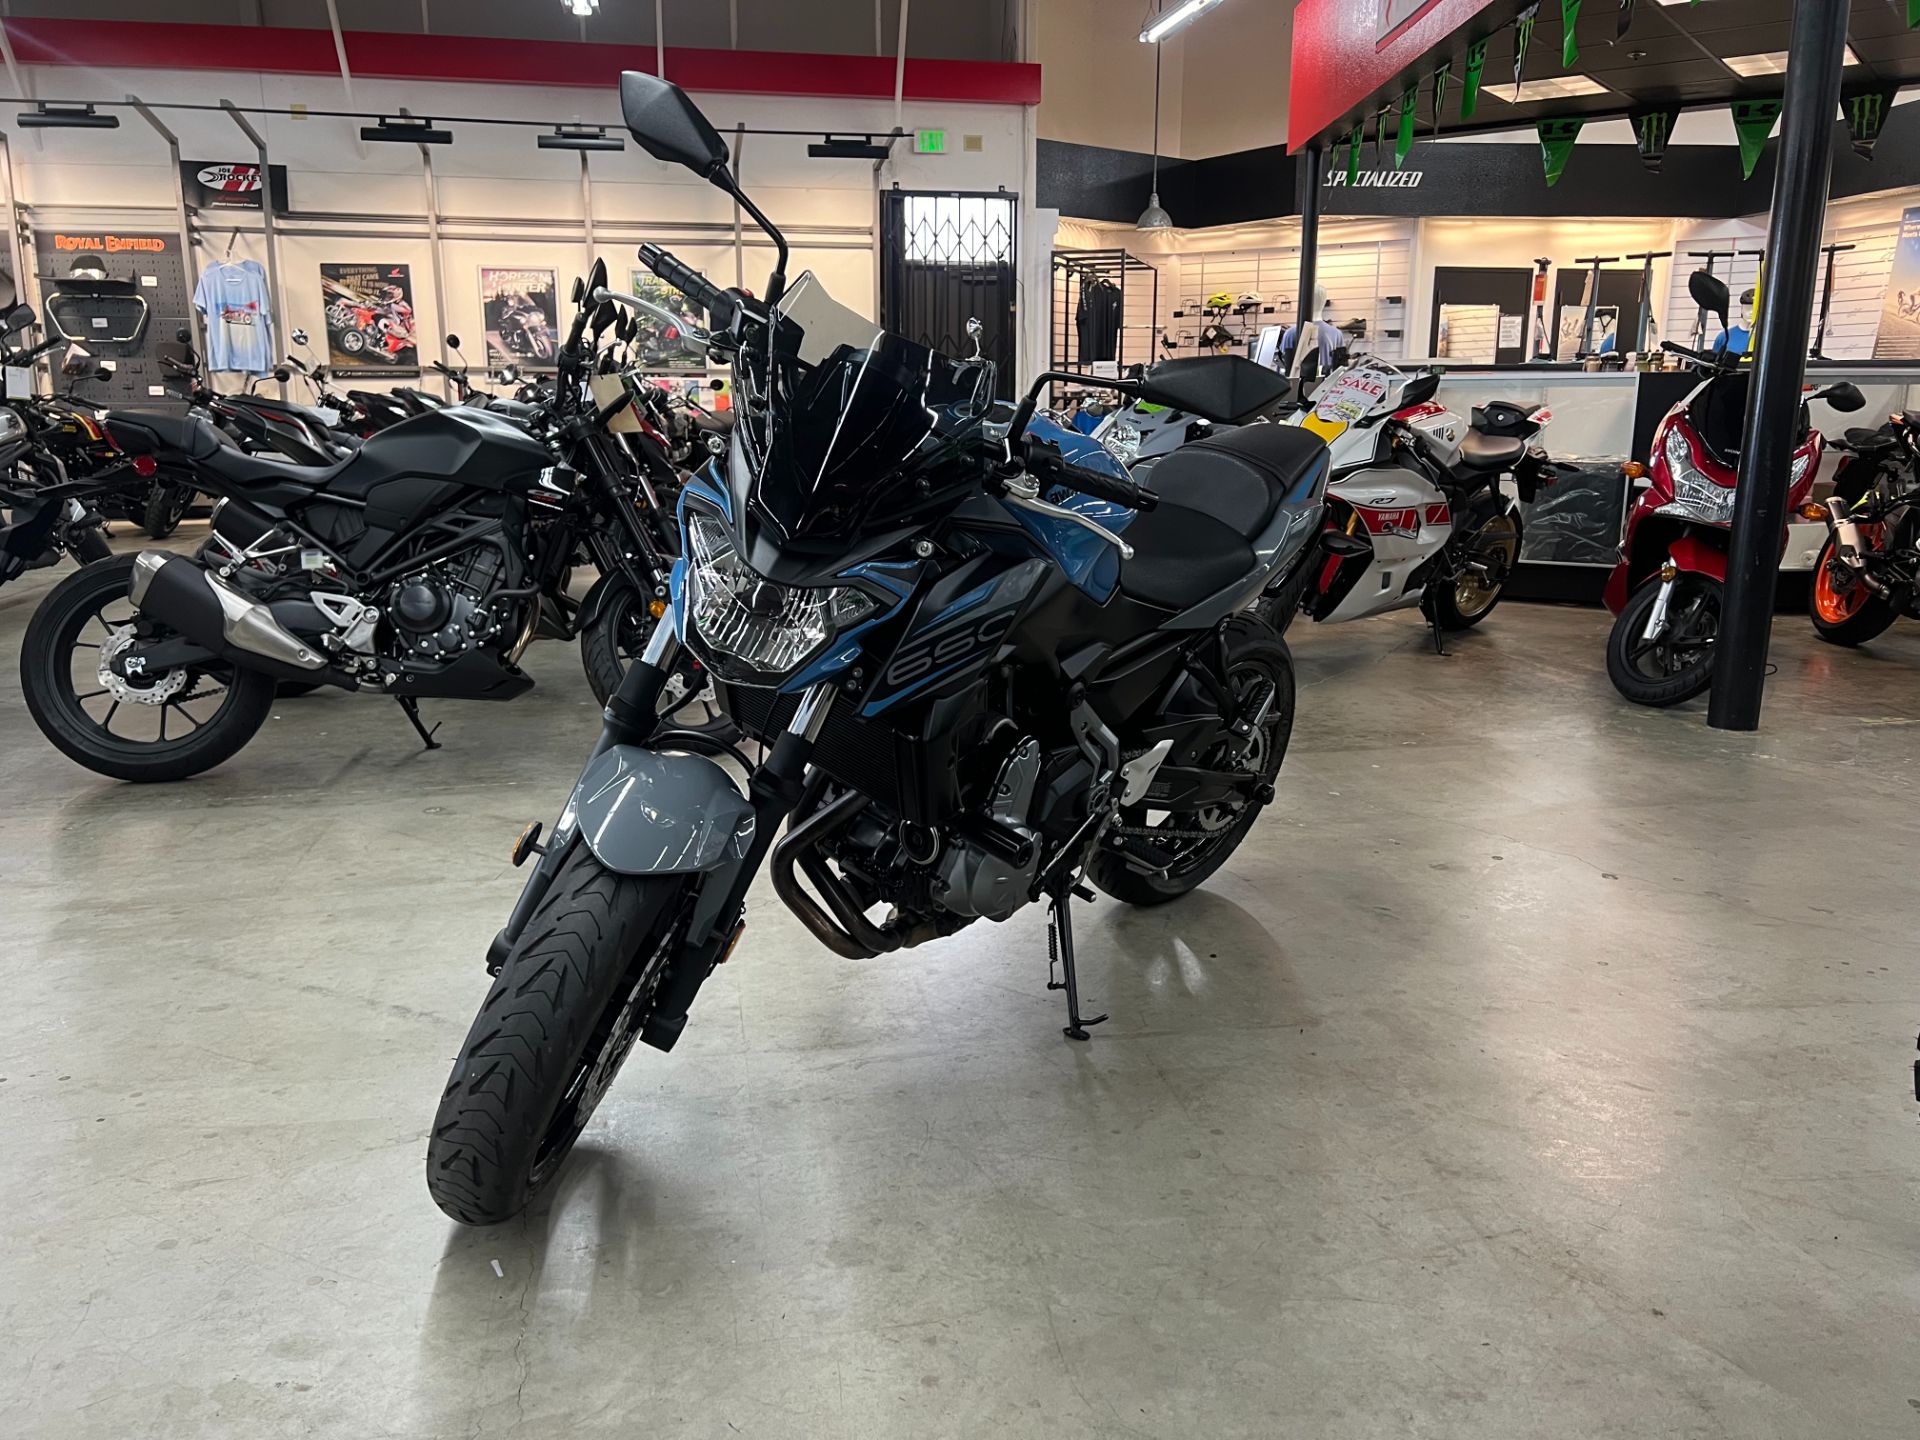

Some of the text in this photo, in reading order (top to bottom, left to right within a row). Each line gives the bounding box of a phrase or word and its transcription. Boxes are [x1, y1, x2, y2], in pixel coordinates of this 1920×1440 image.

[919, 130, 944, 151] EXIT
[1322, 169, 1423, 187] SPCIALIZED
[55, 234, 165, 252] ROYAL ENFIELD
[489, 270, 549, 282] HORIZON
[1339, 377, 1382, 396] SALE
[1377, 511, 1400, 521] YAMAHA
